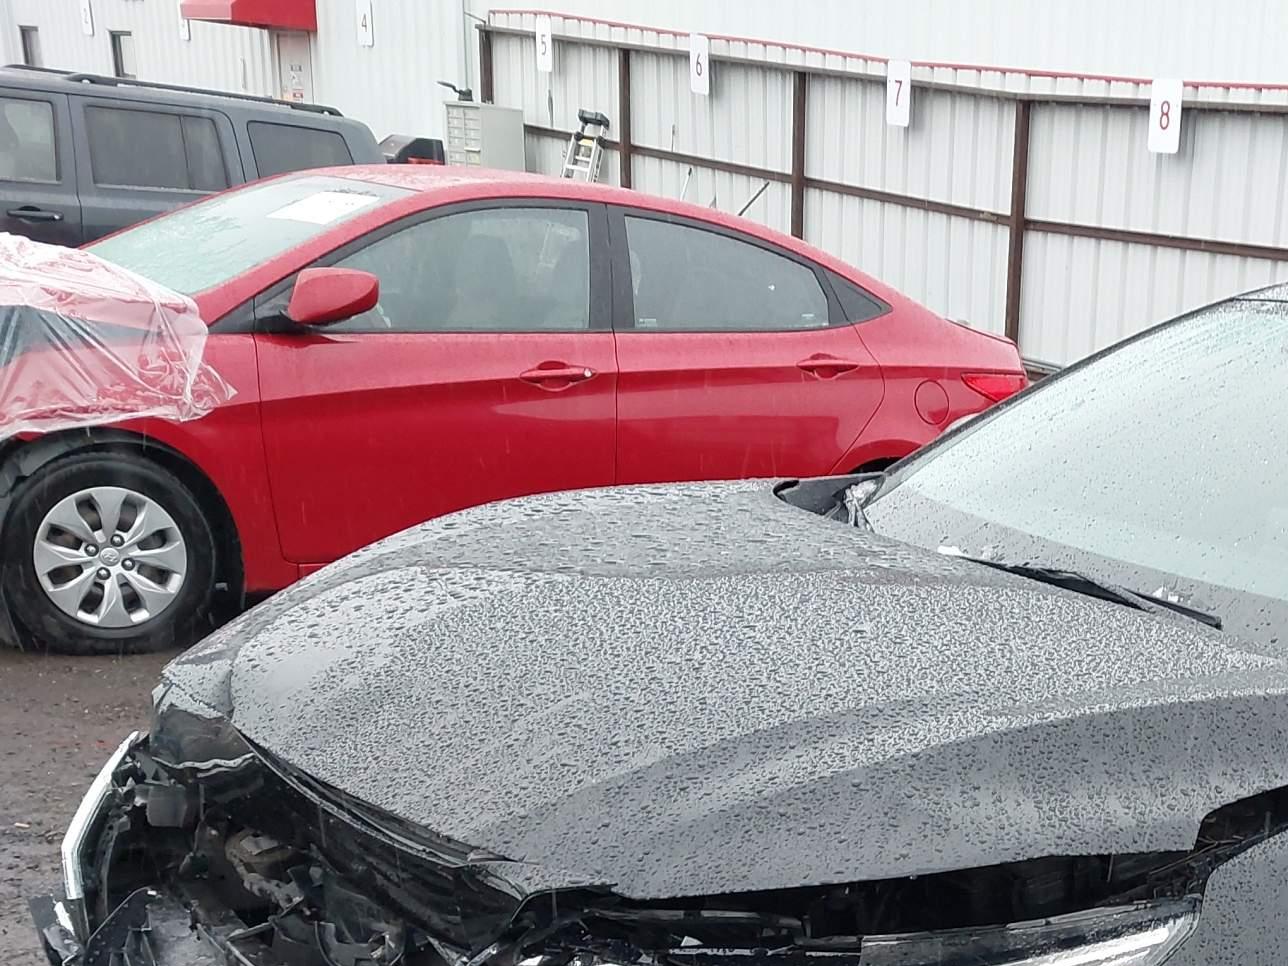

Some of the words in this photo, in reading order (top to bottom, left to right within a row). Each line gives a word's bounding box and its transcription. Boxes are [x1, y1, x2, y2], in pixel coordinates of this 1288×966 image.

[361, 12, 368, 32] 4
[540, 35, 548, 57] 5
[695, 55, 703, 78] 6
[894, 80, 903, 107] 7
[1159, 100, 1170, 131] 8
